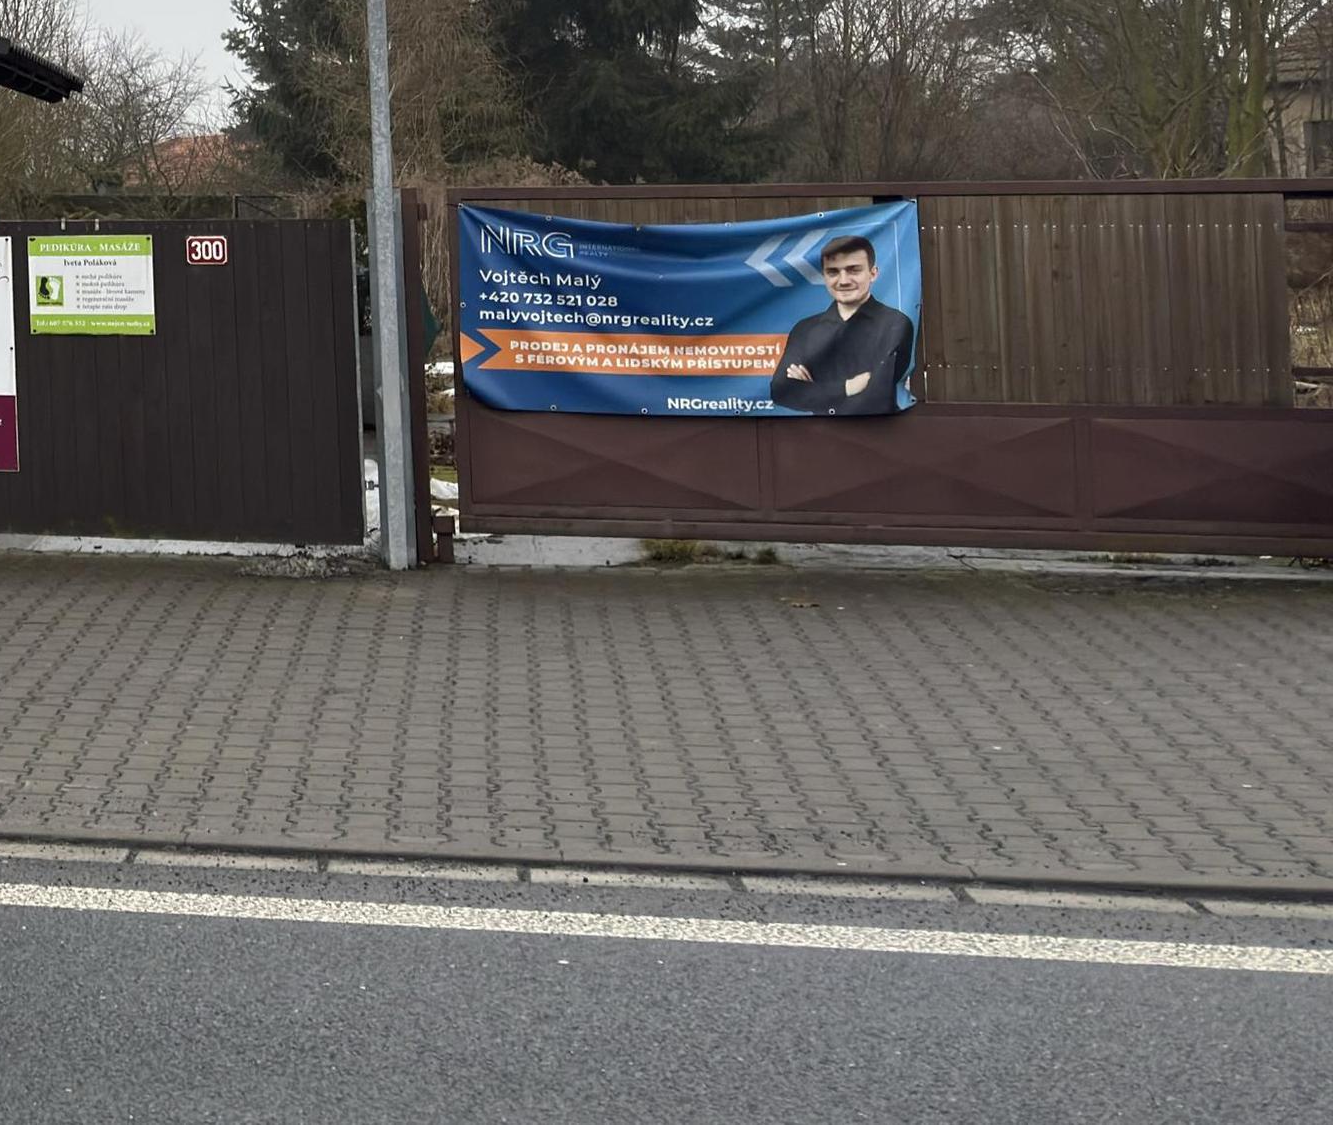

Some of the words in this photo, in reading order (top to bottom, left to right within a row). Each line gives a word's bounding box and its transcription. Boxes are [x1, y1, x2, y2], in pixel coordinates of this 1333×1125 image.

[40, 242, 91, 252] PEDIKÚRA
[99, 242, 141, 252] MASÁŽE
[480, 224, 575, 259] NRG
[191, 240, 223, 261] 300
[63, 259, 81, 267] Iveta
[83, 258, 117, 267] Poláková
[478, 269, 551, 287] Vojtěch
[556, 273, 601, 290] Malý
[479, 291, 520, 304] +420
[523, 292, 553, 305] 732
[556, 294, 582, 307] 521
[586, 295, 618, 307] 028
[478, 308, 714, 328] malyvojtech@nrgreality.cz
[510, 340, 569, 352] PRODEJ
[571, 343, 582, 352] A
[586, 342, 671, 355] PRONÁJEM
[673, 342, 781, 355] NEMOVITOSTÍ
[514, 354, 525, 364] S
[527, 353, 599, 366] FÉROVÝM
[601, 357, 611, 366] A
[615, 356, 683, 368] LIDSKÝM
[687, 357, 776, 369] PŘÍSTUPEM
[667, 398, 774, 412] NRGreality.cz
